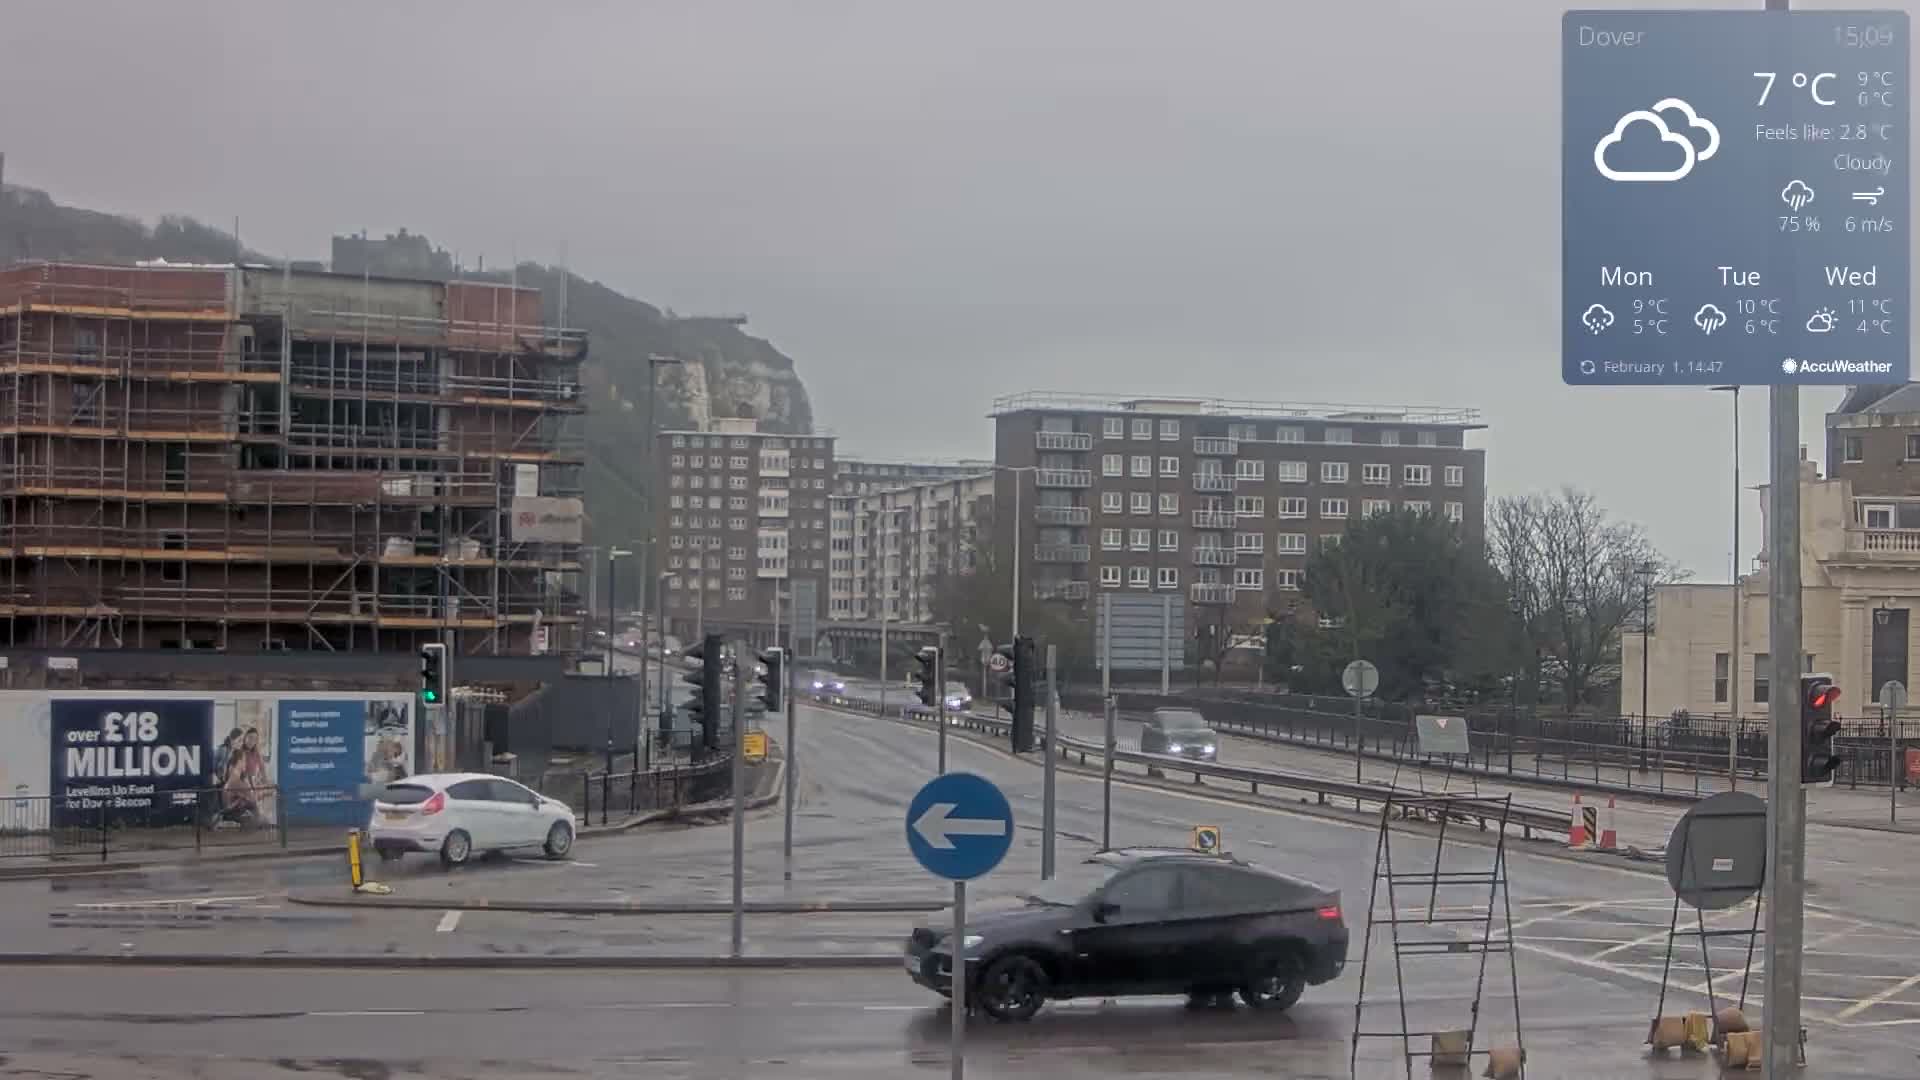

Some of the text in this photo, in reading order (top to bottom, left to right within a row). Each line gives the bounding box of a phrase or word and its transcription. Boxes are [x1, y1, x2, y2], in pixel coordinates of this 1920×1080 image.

[67, 712, 159, 742] over £18
[66, 745, 200, 777] MILLION
[129, 785, 154, 794] Fund
